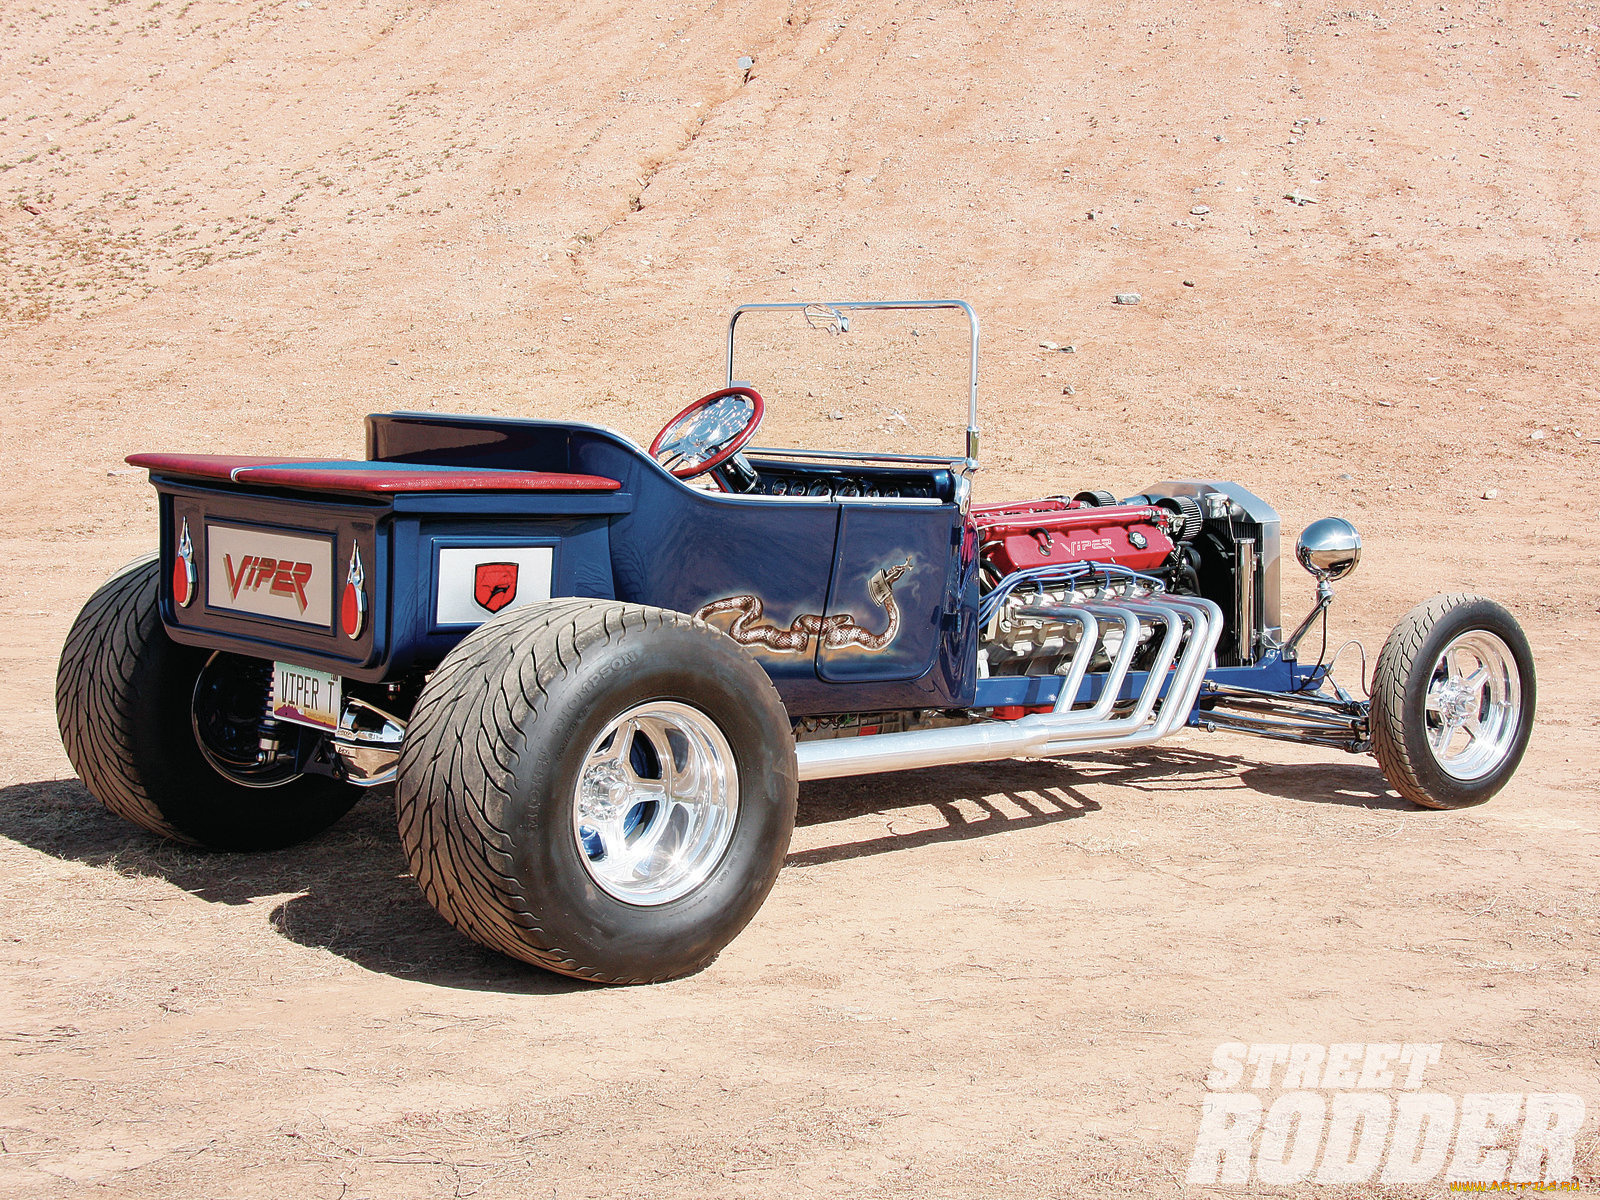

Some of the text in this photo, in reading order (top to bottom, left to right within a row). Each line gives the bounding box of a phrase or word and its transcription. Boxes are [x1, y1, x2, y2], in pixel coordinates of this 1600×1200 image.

[1060, 538, 1115, 556] VIPER
[223, 553, 312, 616] VIPER
[281, 671, 335, 713] VIPER T
